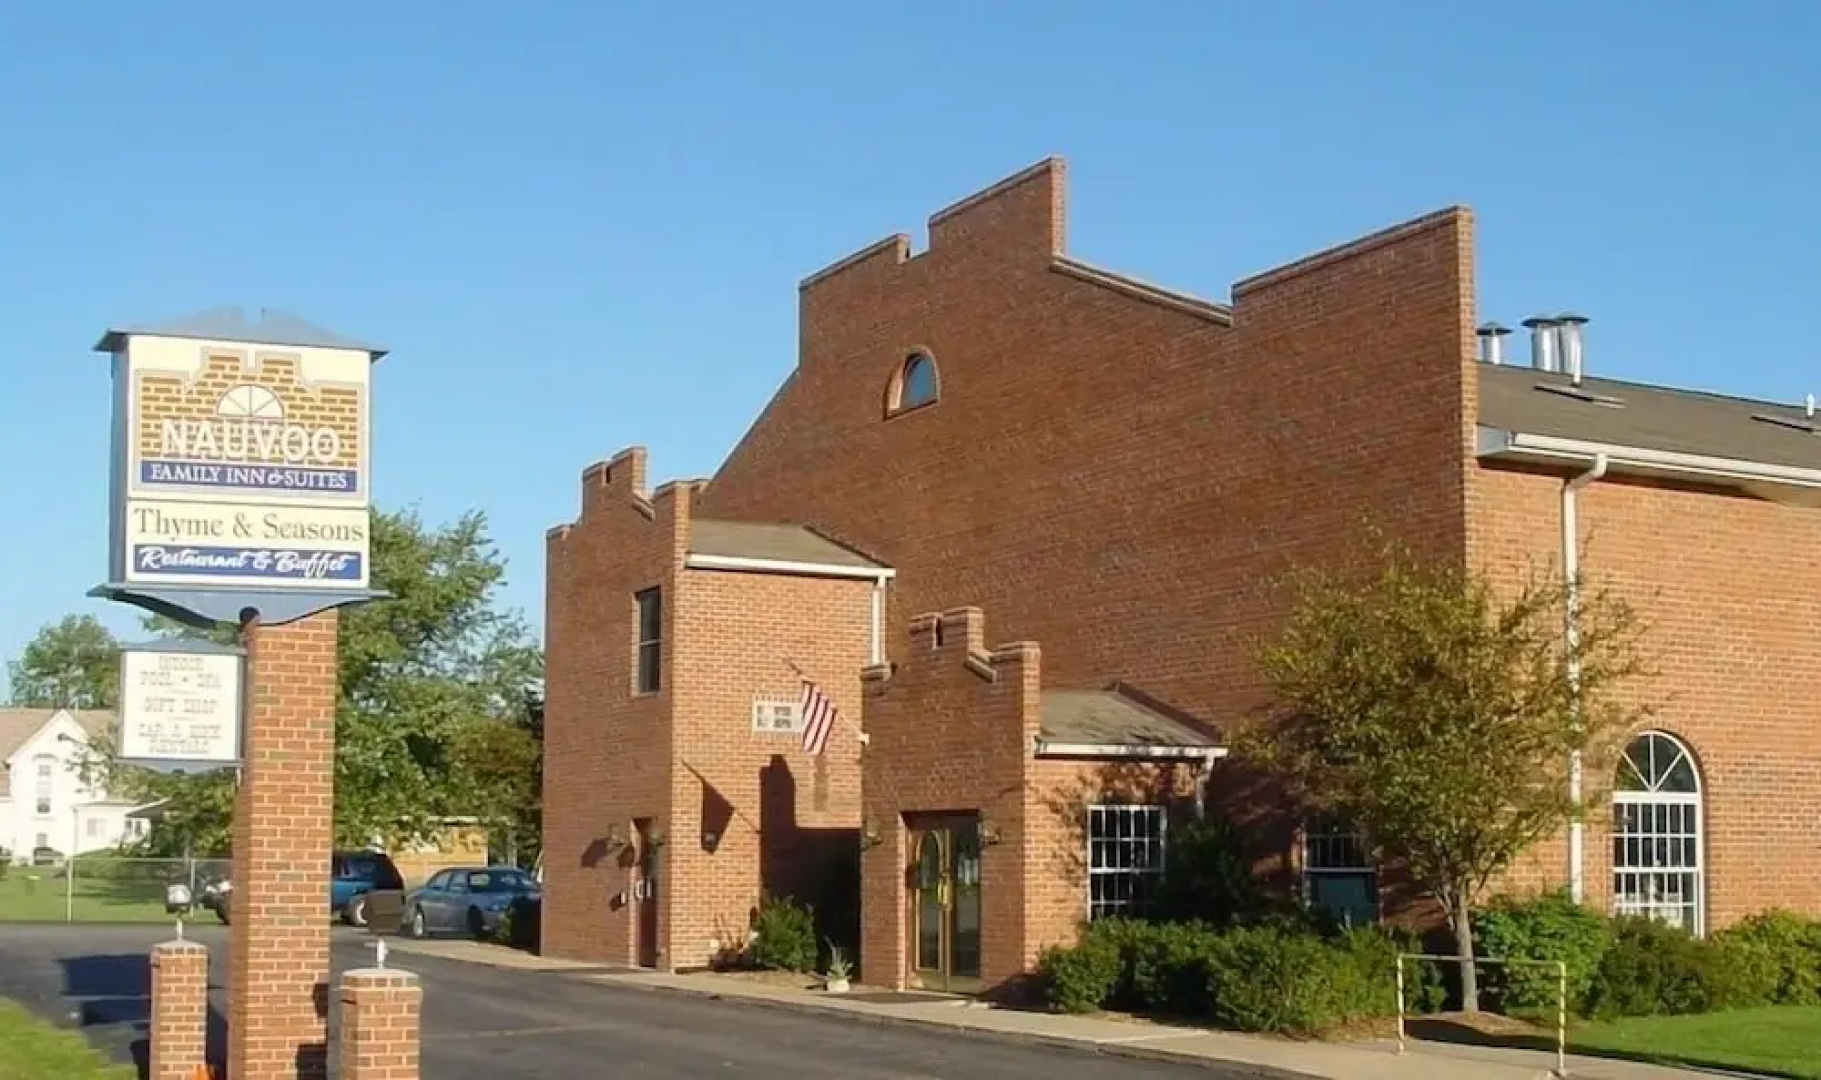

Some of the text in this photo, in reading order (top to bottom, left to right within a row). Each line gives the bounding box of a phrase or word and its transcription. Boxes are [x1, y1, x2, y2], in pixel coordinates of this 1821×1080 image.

[162, 418, 341, 462] NAUVOO
[151, 463, 348, 489] FAMILY INN & SUITES
[134, 507, 365, 541] Thyme & Seasons
[139, 546, 358, 578] Restaurant & Buffet
